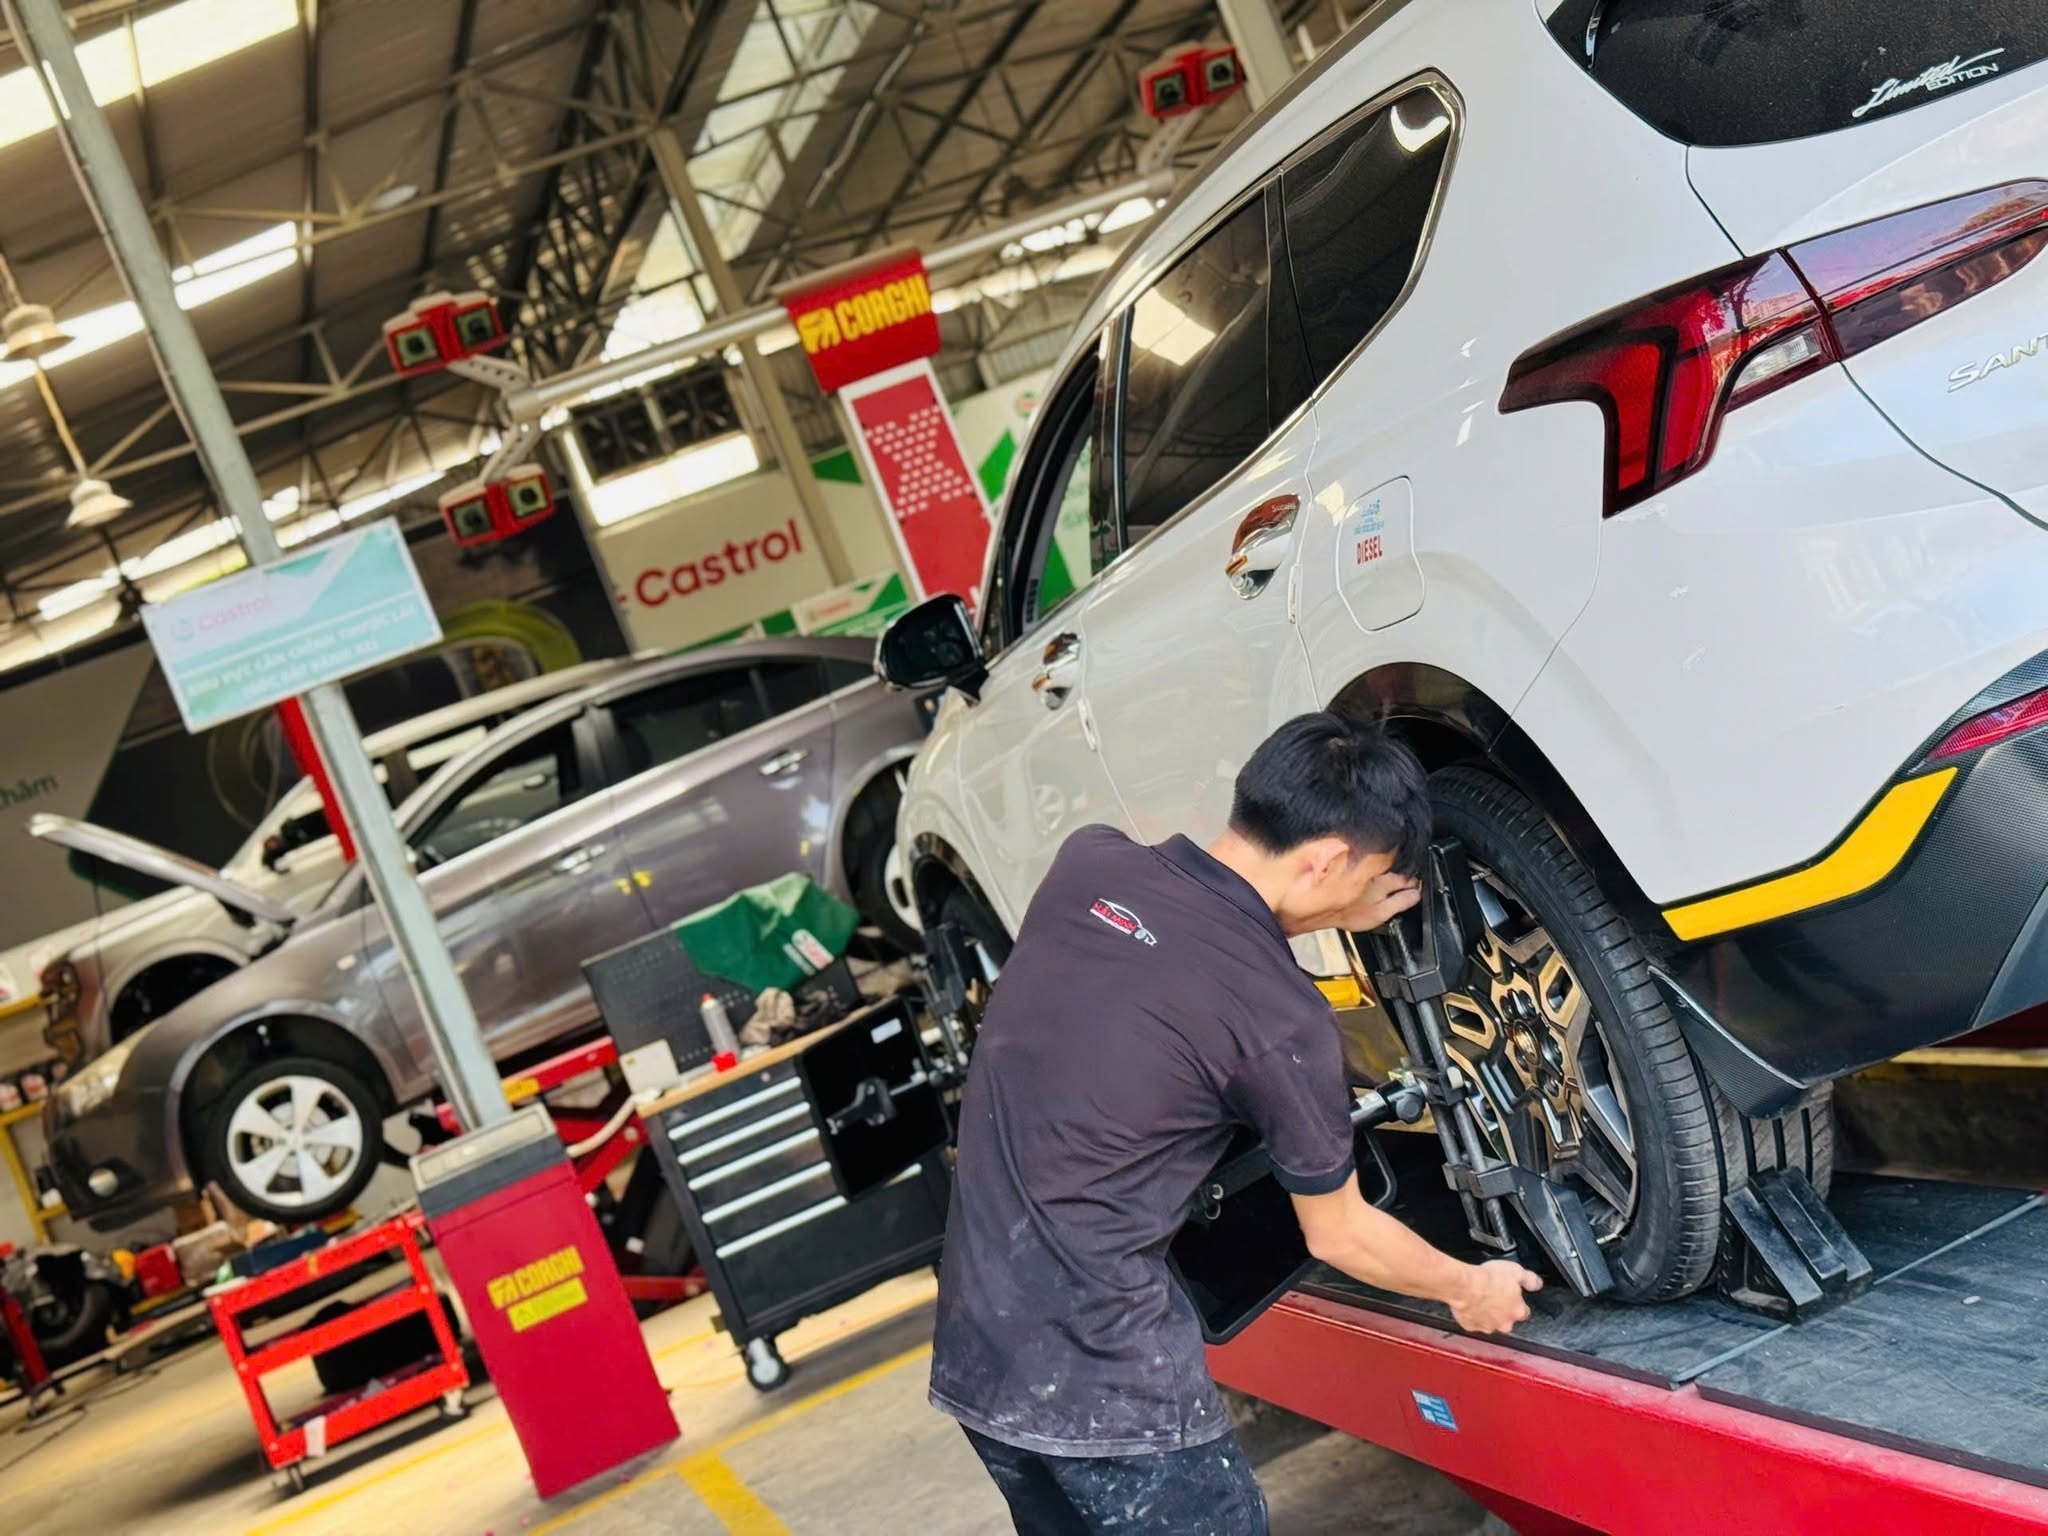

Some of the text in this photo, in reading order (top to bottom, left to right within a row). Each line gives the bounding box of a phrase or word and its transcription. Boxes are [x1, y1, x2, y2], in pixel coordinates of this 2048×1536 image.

[1852, 48, 2005, 118] Limited
[1925, 62, 1999, 92] EDITION
[834, 273, 931, 341] CORGHI
[634, 518, 803, 608] Castrol
[1357, 535, 1383, 565] DIESEL
